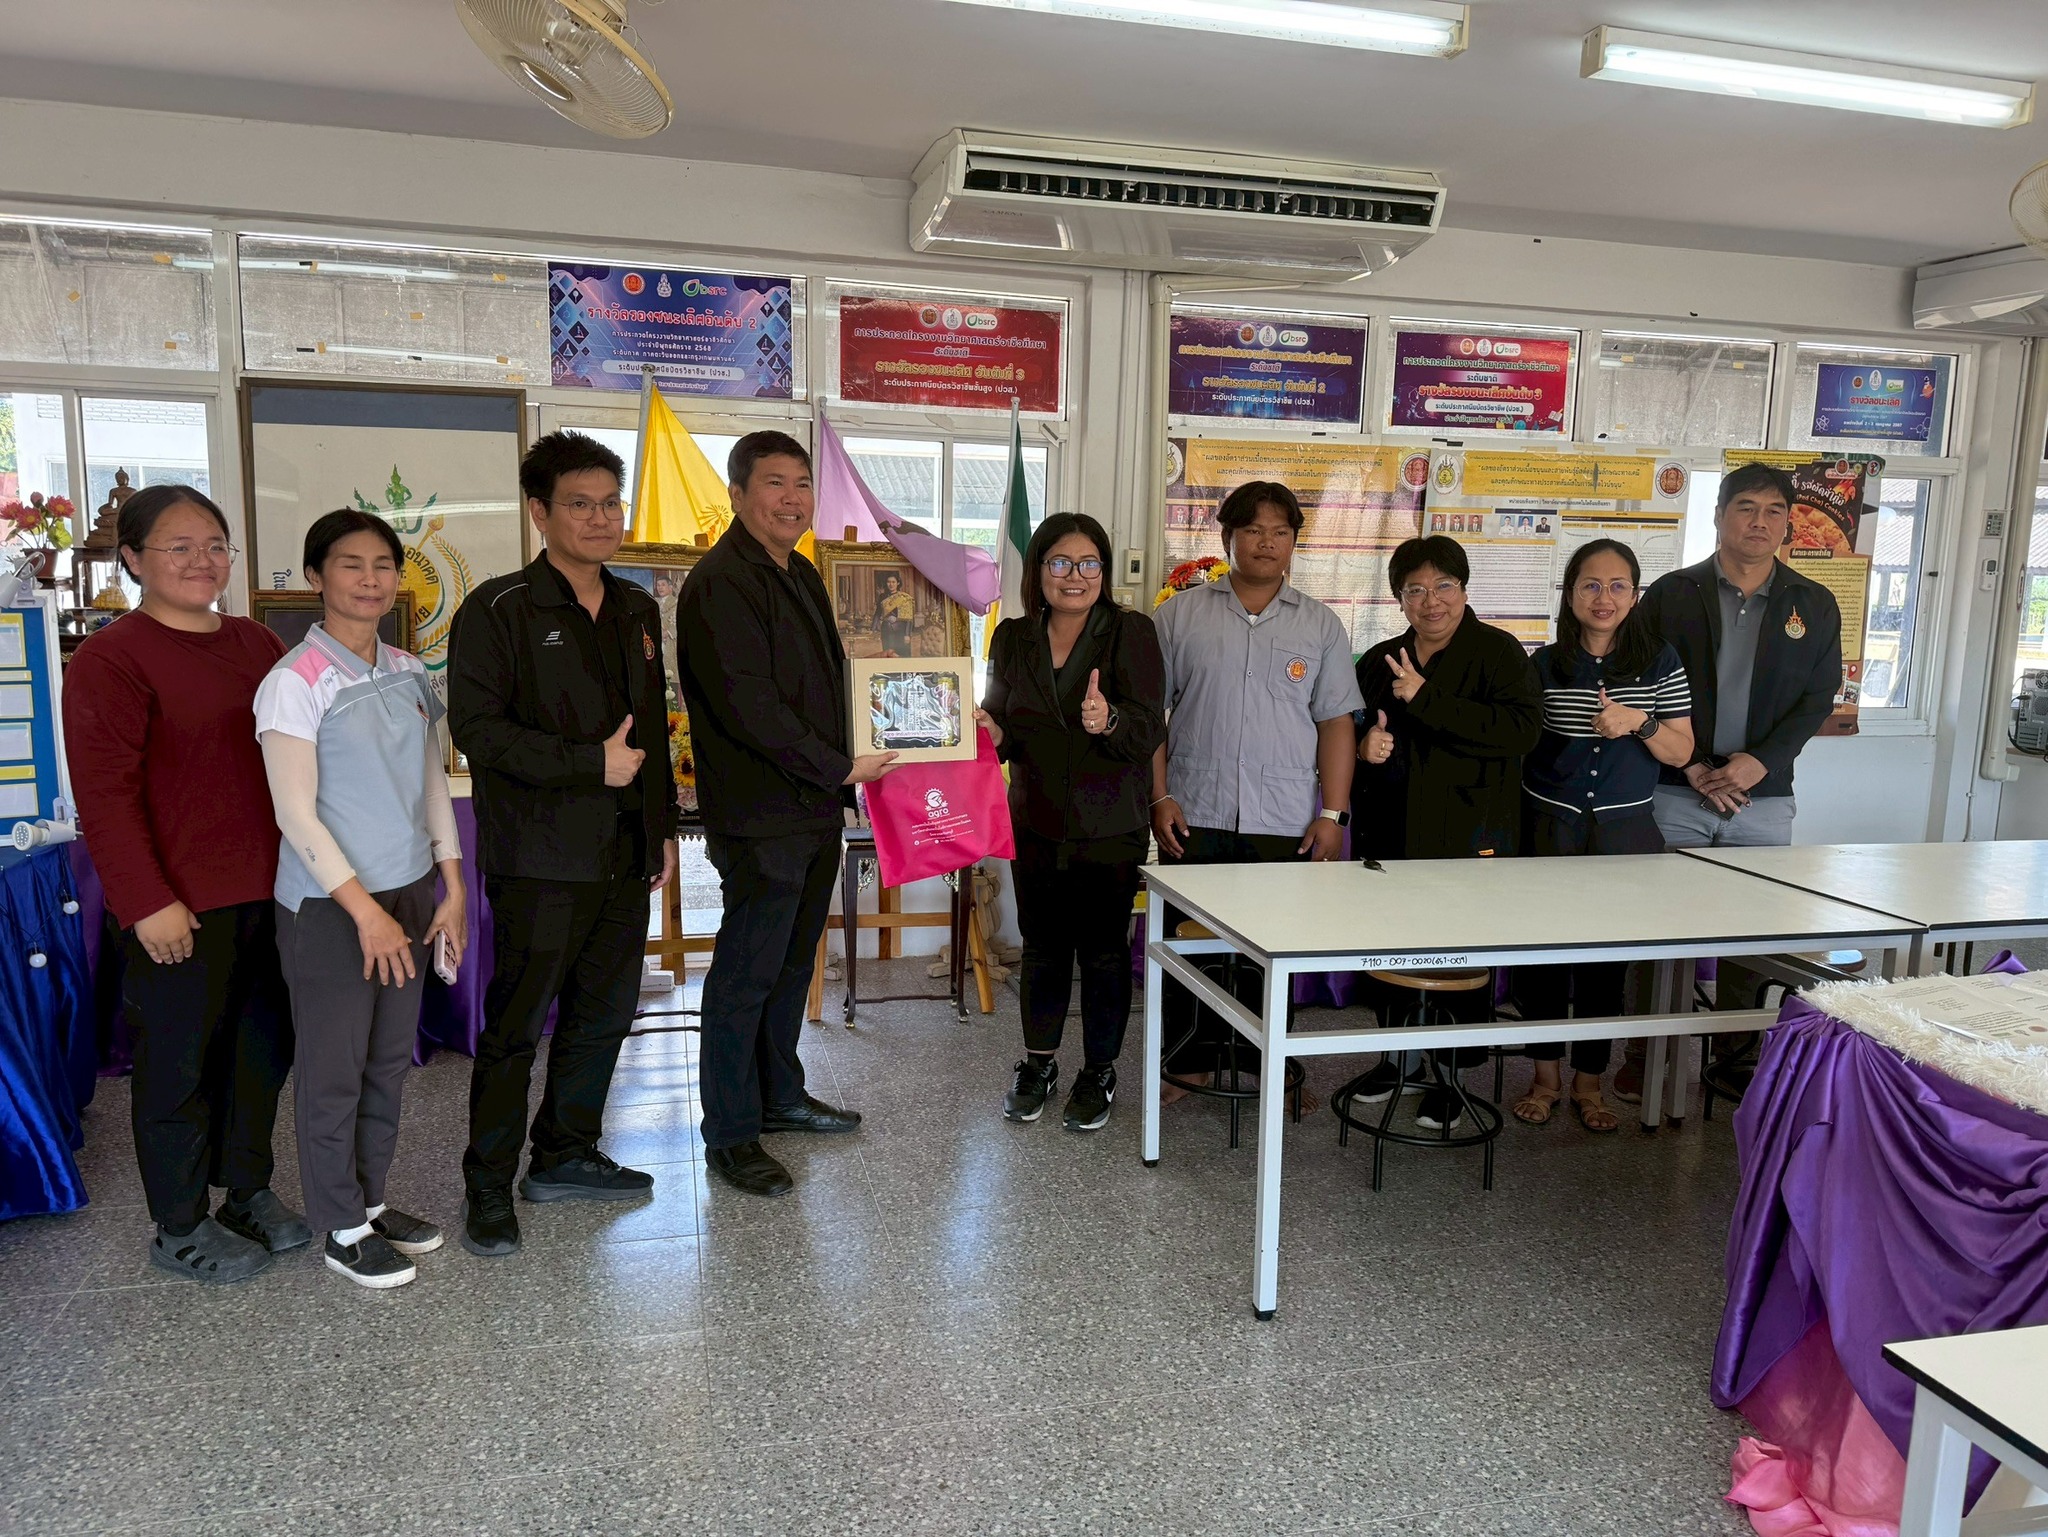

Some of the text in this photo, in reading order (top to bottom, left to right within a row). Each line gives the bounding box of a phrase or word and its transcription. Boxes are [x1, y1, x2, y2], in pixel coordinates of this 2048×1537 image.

[587, 302, 758, 329] รางวัลรองชนะเลิศอันดับ 2
[977, 317, 996, 327] bsrc
[854, 327, 1047, 350] การประกวดโครงงานวิทยาศาสตร์อาชีวศึกษา
[1290, 335, 1307, 343] bsrc
[934, 346, 970, 358] ระดับชาติ
[1015, 369, 1026, 380] 3
[1466, 373, 1498, 383] ระดับชาติ
[883, 378, 1018, 395] ระดับประกาศนียบัตรวิชาชีพชั้นสูง (ปวส.)
[1317, 383, 1326, 394] 2
[1294, 395, 1316, 406] (ปวช.)
[1534, 390, 1543, 400] 3
[1506, 405, 1524, 414] (ปวช.)
[1824, 502, 1845, 521] Cookies
[928, 807, 949, 818] agro
